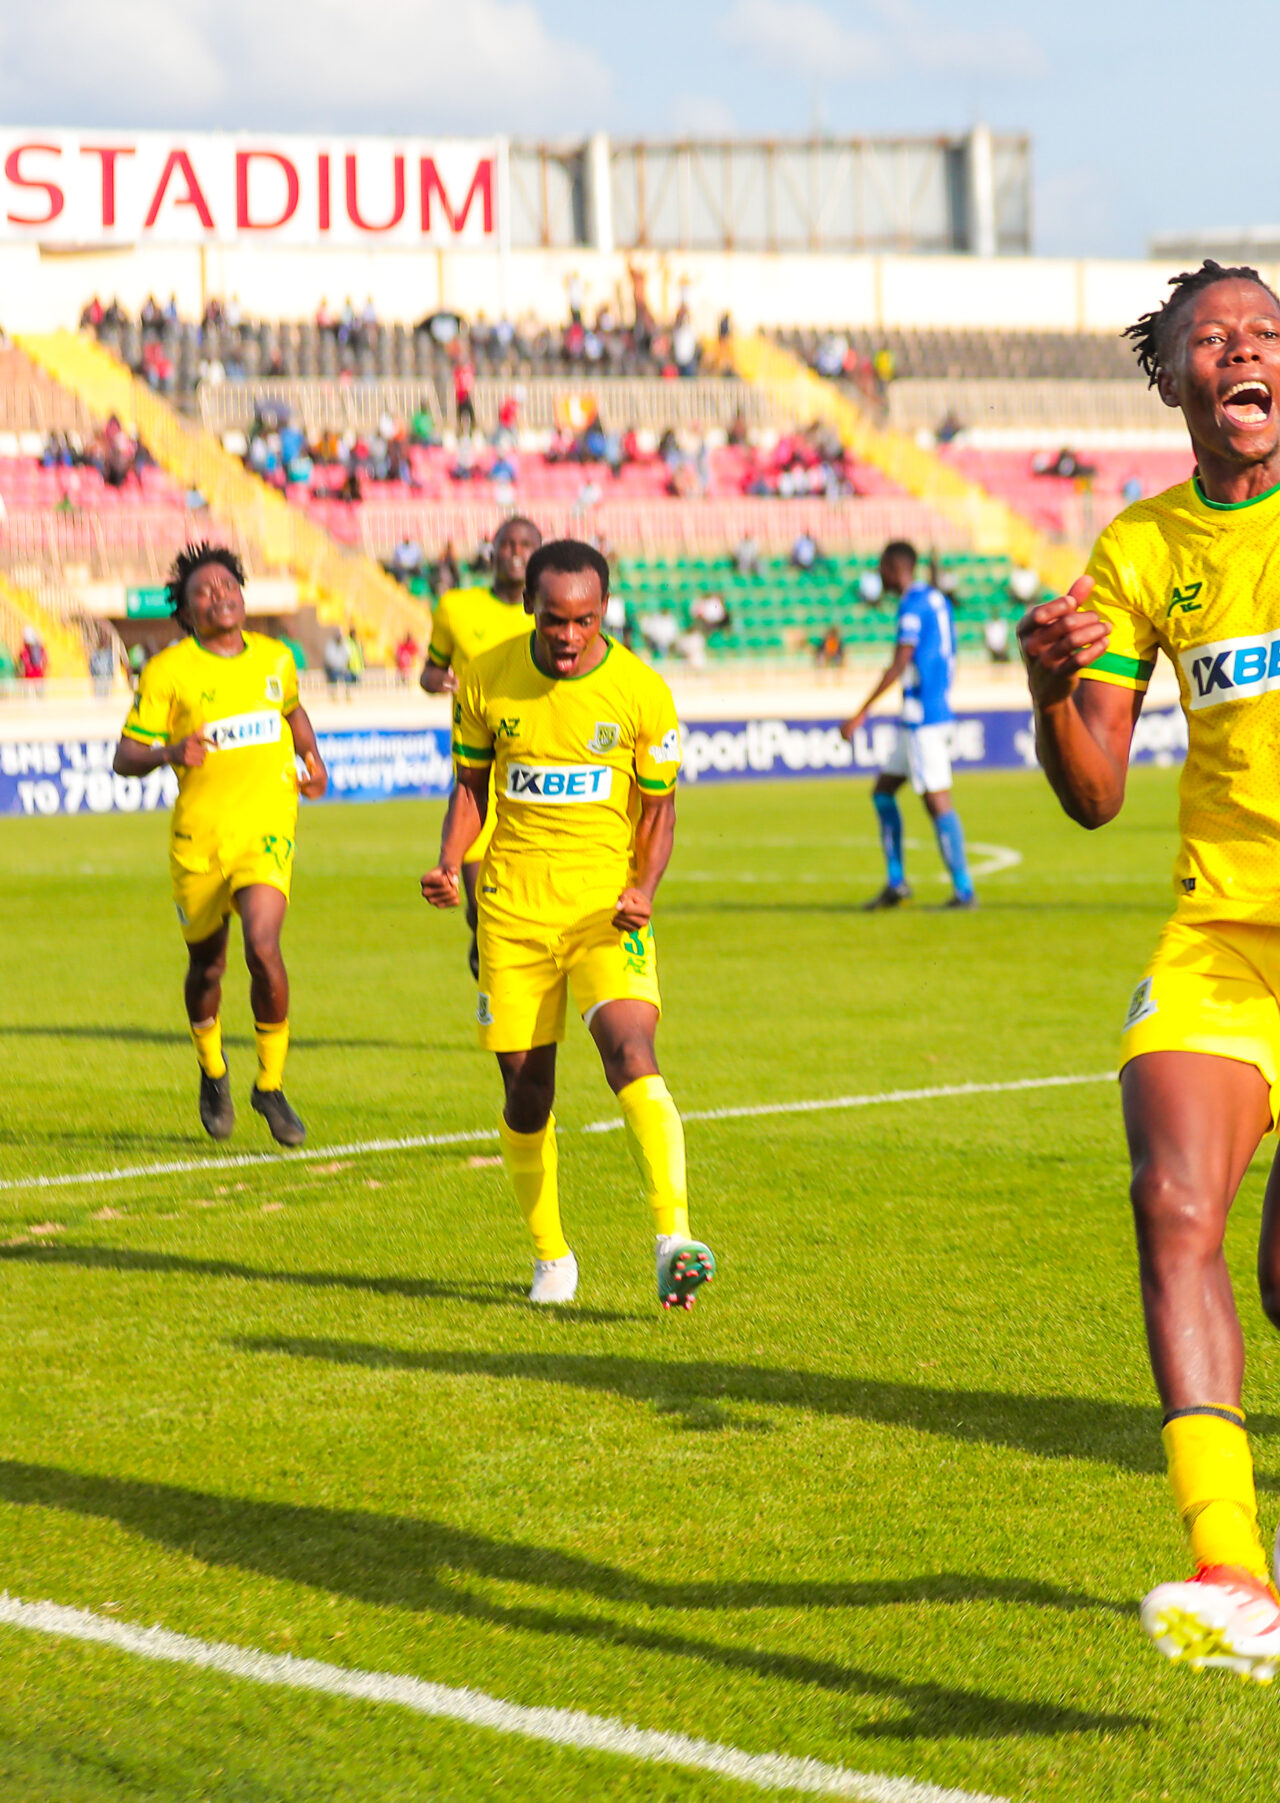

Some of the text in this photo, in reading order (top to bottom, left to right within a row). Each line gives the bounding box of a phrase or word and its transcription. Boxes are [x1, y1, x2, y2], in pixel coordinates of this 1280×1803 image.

[5, 144, 495, 234] STADIUM
[17, 780, 60, 815] TO
[511, 766, 607, 795] 1XBET
